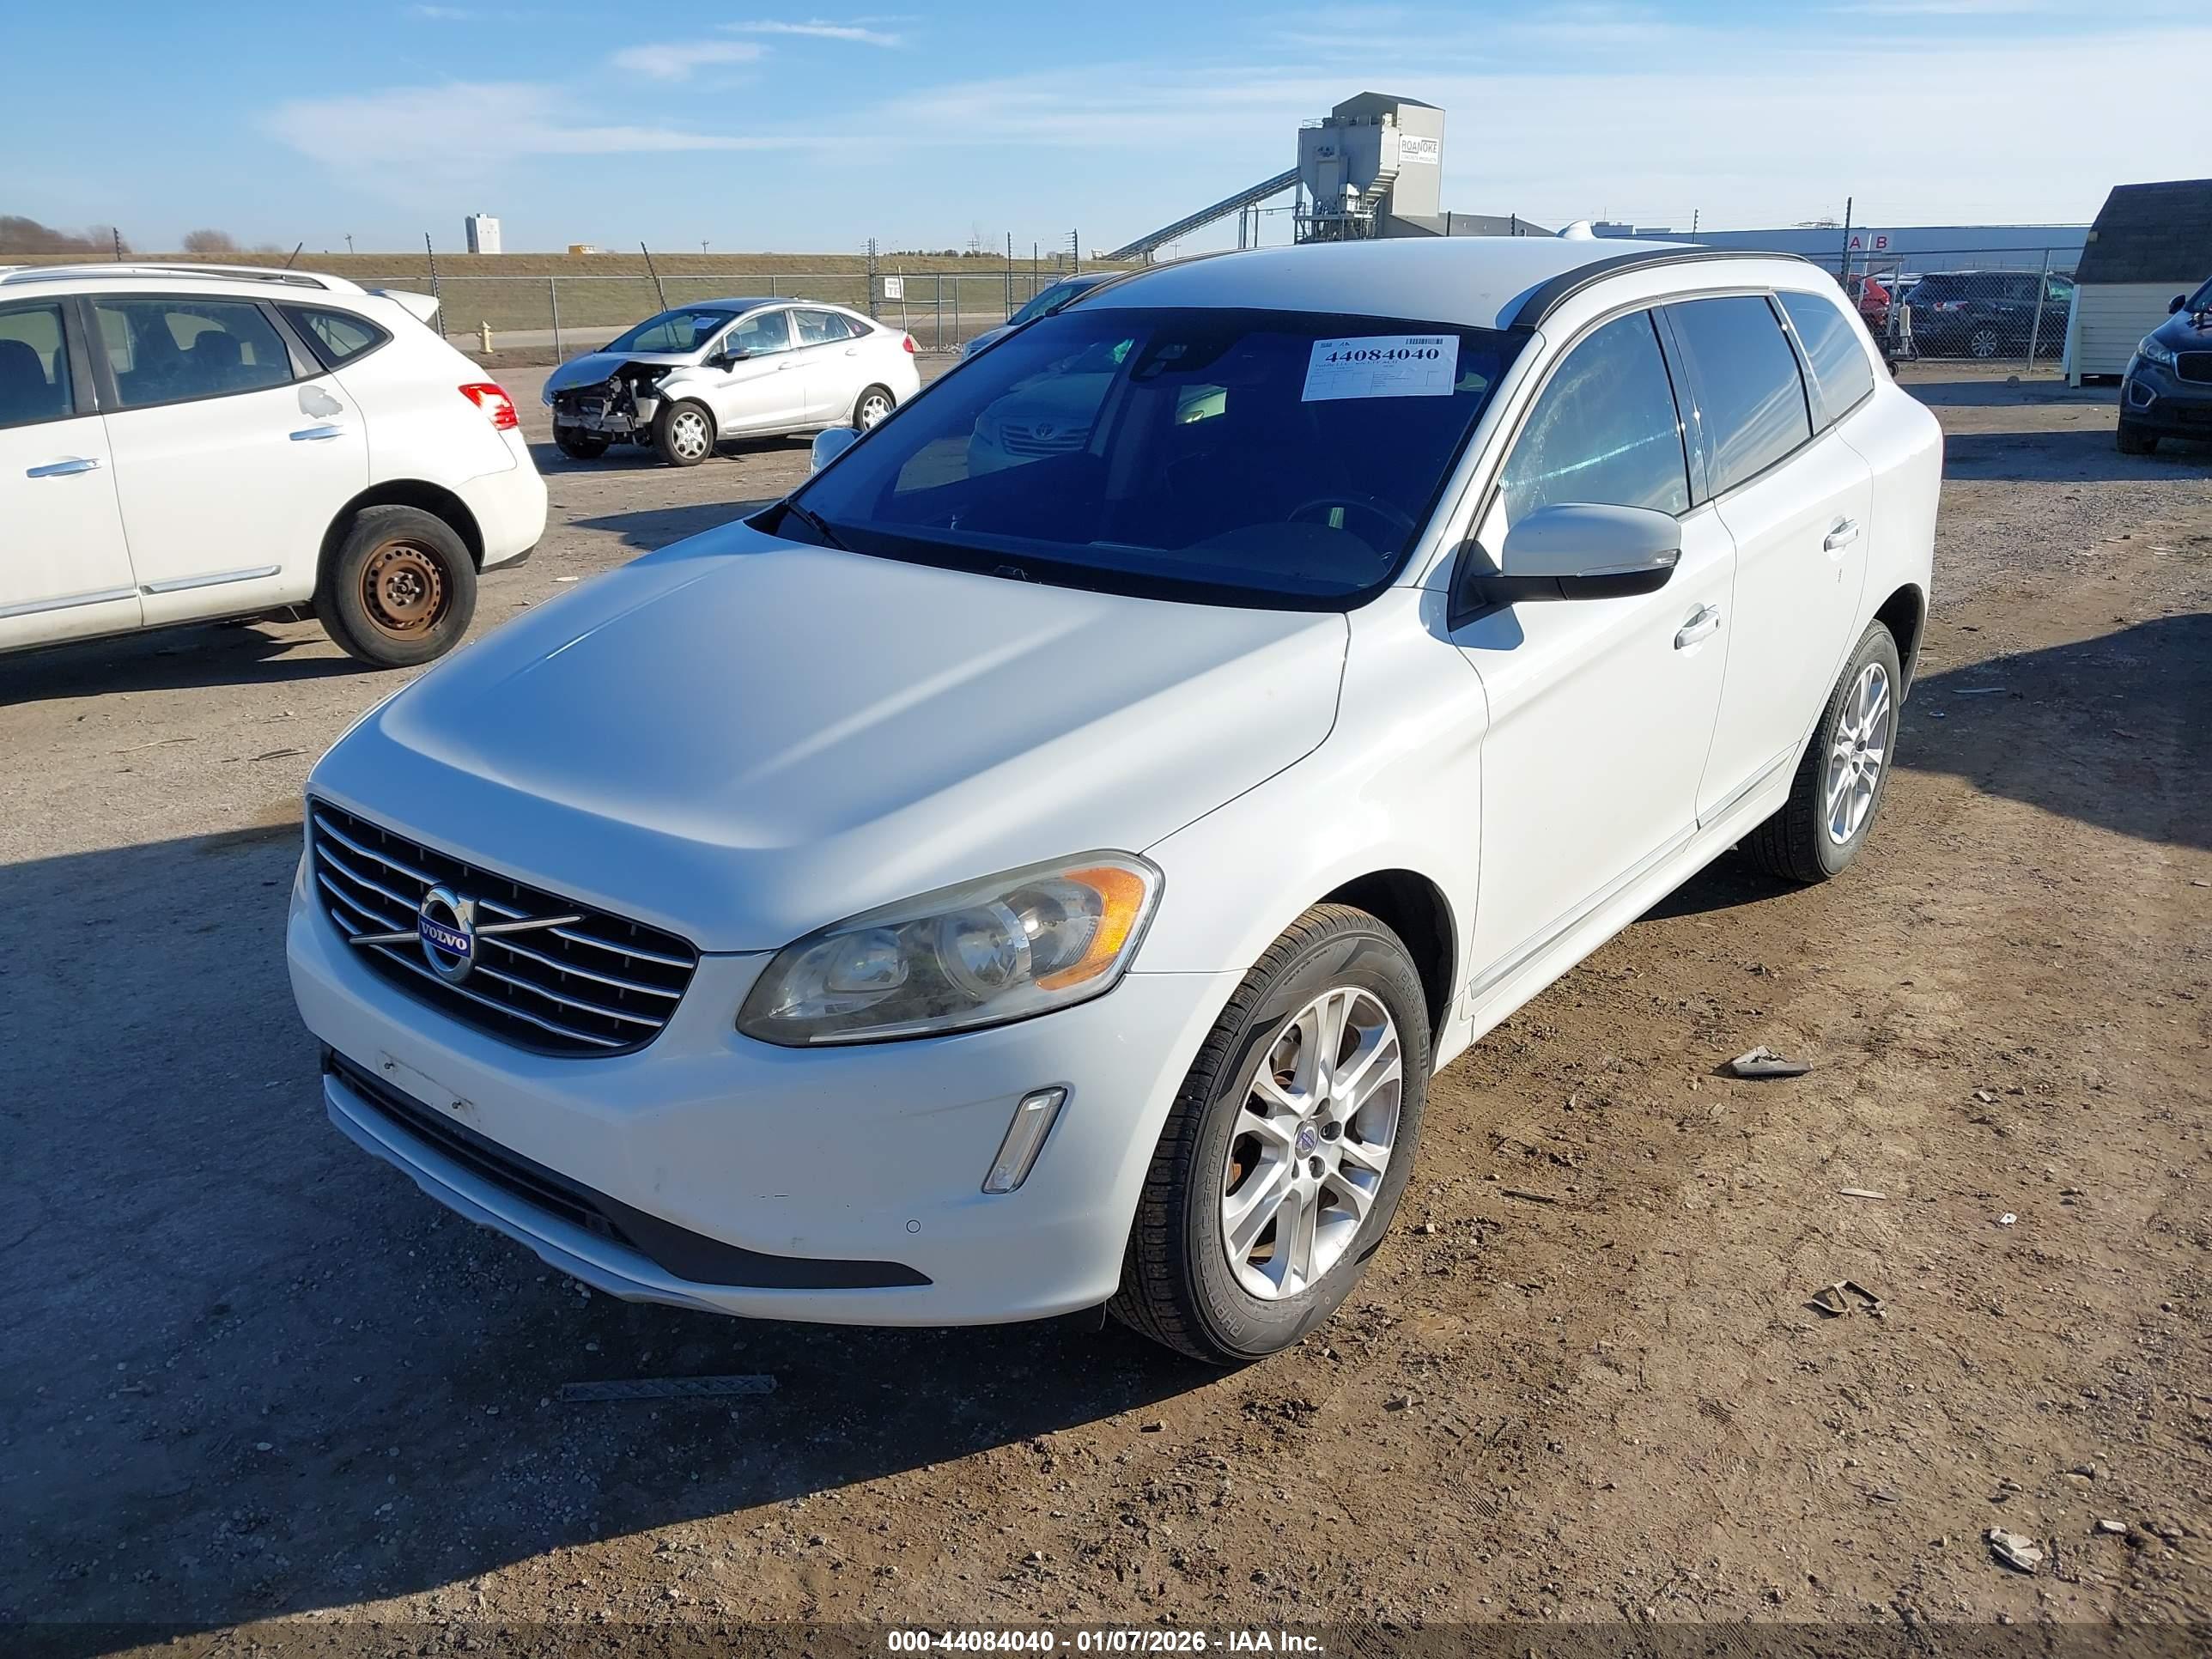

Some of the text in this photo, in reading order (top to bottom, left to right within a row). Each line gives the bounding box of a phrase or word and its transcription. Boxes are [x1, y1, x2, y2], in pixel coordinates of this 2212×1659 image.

[1401, 139, 1437, 154] ROANOKE
[1849, 236, 1861, 249] A
[1875, 236, 1887, 249] B
[1325, 348, 1439, 362] 44084040
[420, 921, 468, 951] VOLVO
